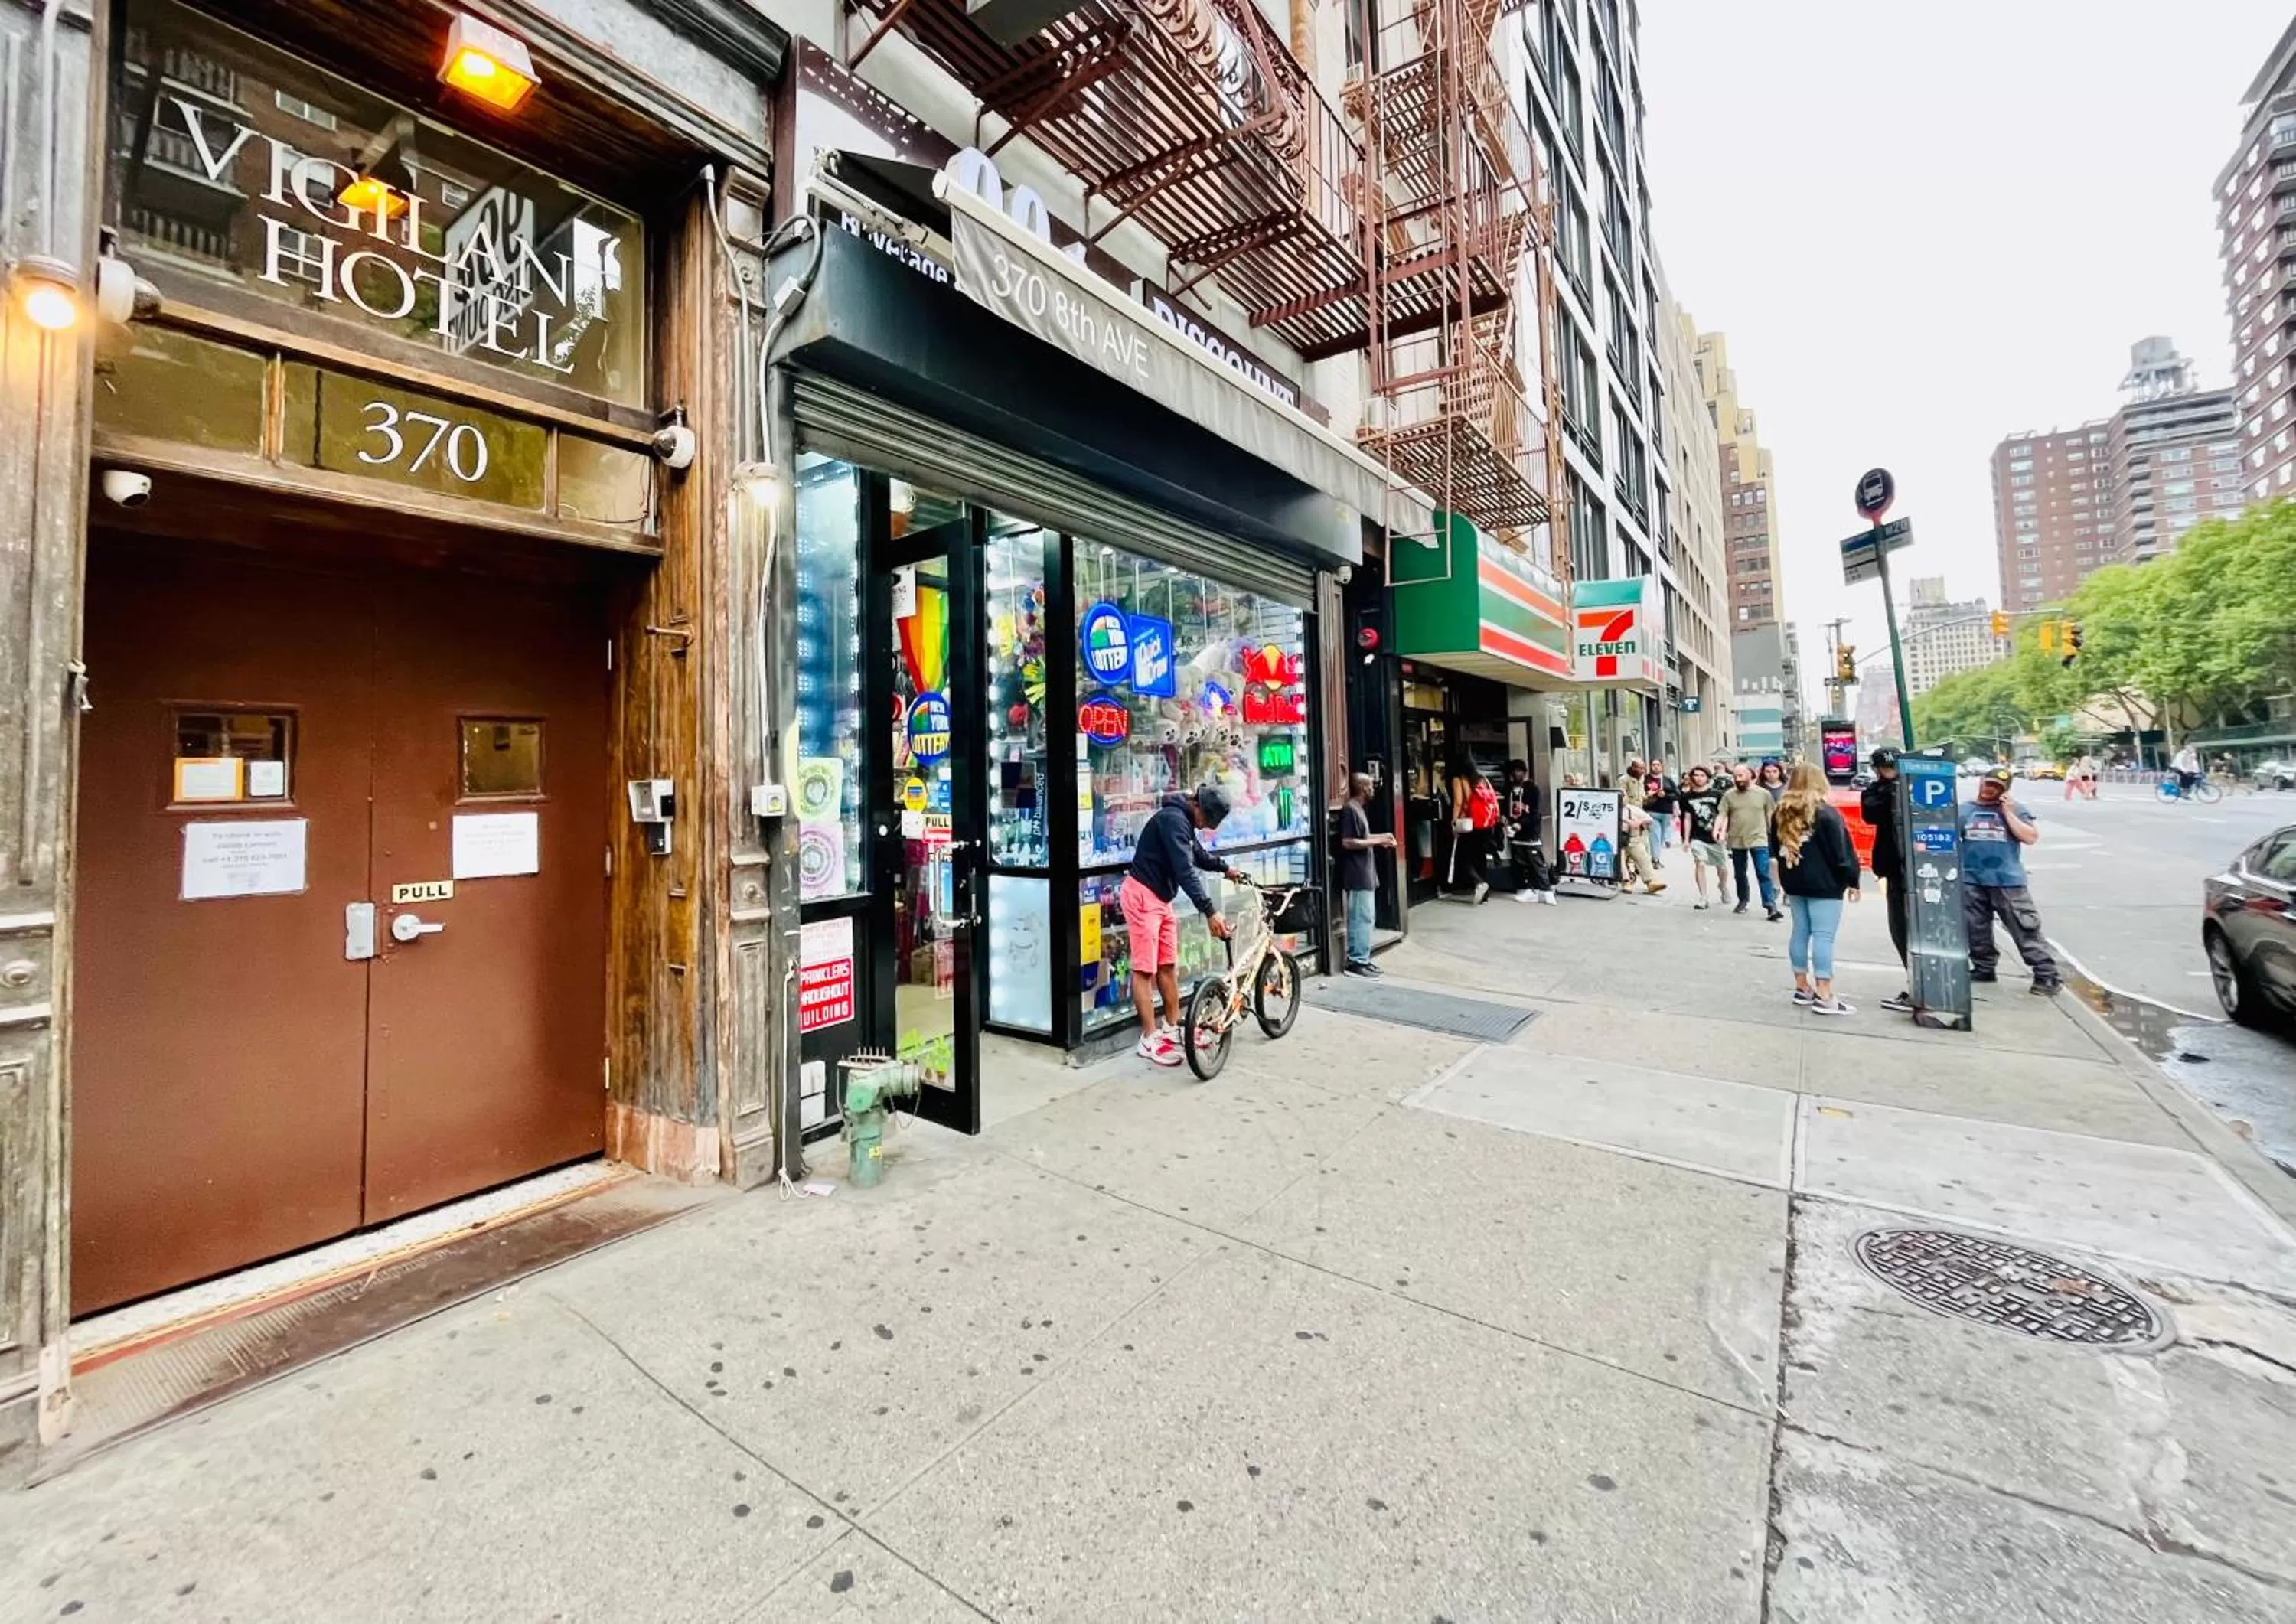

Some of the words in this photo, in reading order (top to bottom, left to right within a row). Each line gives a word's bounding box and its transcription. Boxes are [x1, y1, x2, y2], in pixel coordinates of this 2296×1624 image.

[257, 214, 576, 375] HOTEL
[992, 254, 1046, 316] 370
[1055, 290, 1095, 347] 8th
[1103, 321, 1149, 379] AVE
[357, 401, 488, 482] 370
[1579, 609, 1634, 676] 7
[1078, 703, 1127, 738] OPEN
[1264, 745, 1292, 767] ATM
[1924, 779, 1945, 804] P
[925, 817, 950, 827] PULL
[399, 885, 448, 900] PULL
[801, 961, 850, 986] PRINKLERS
